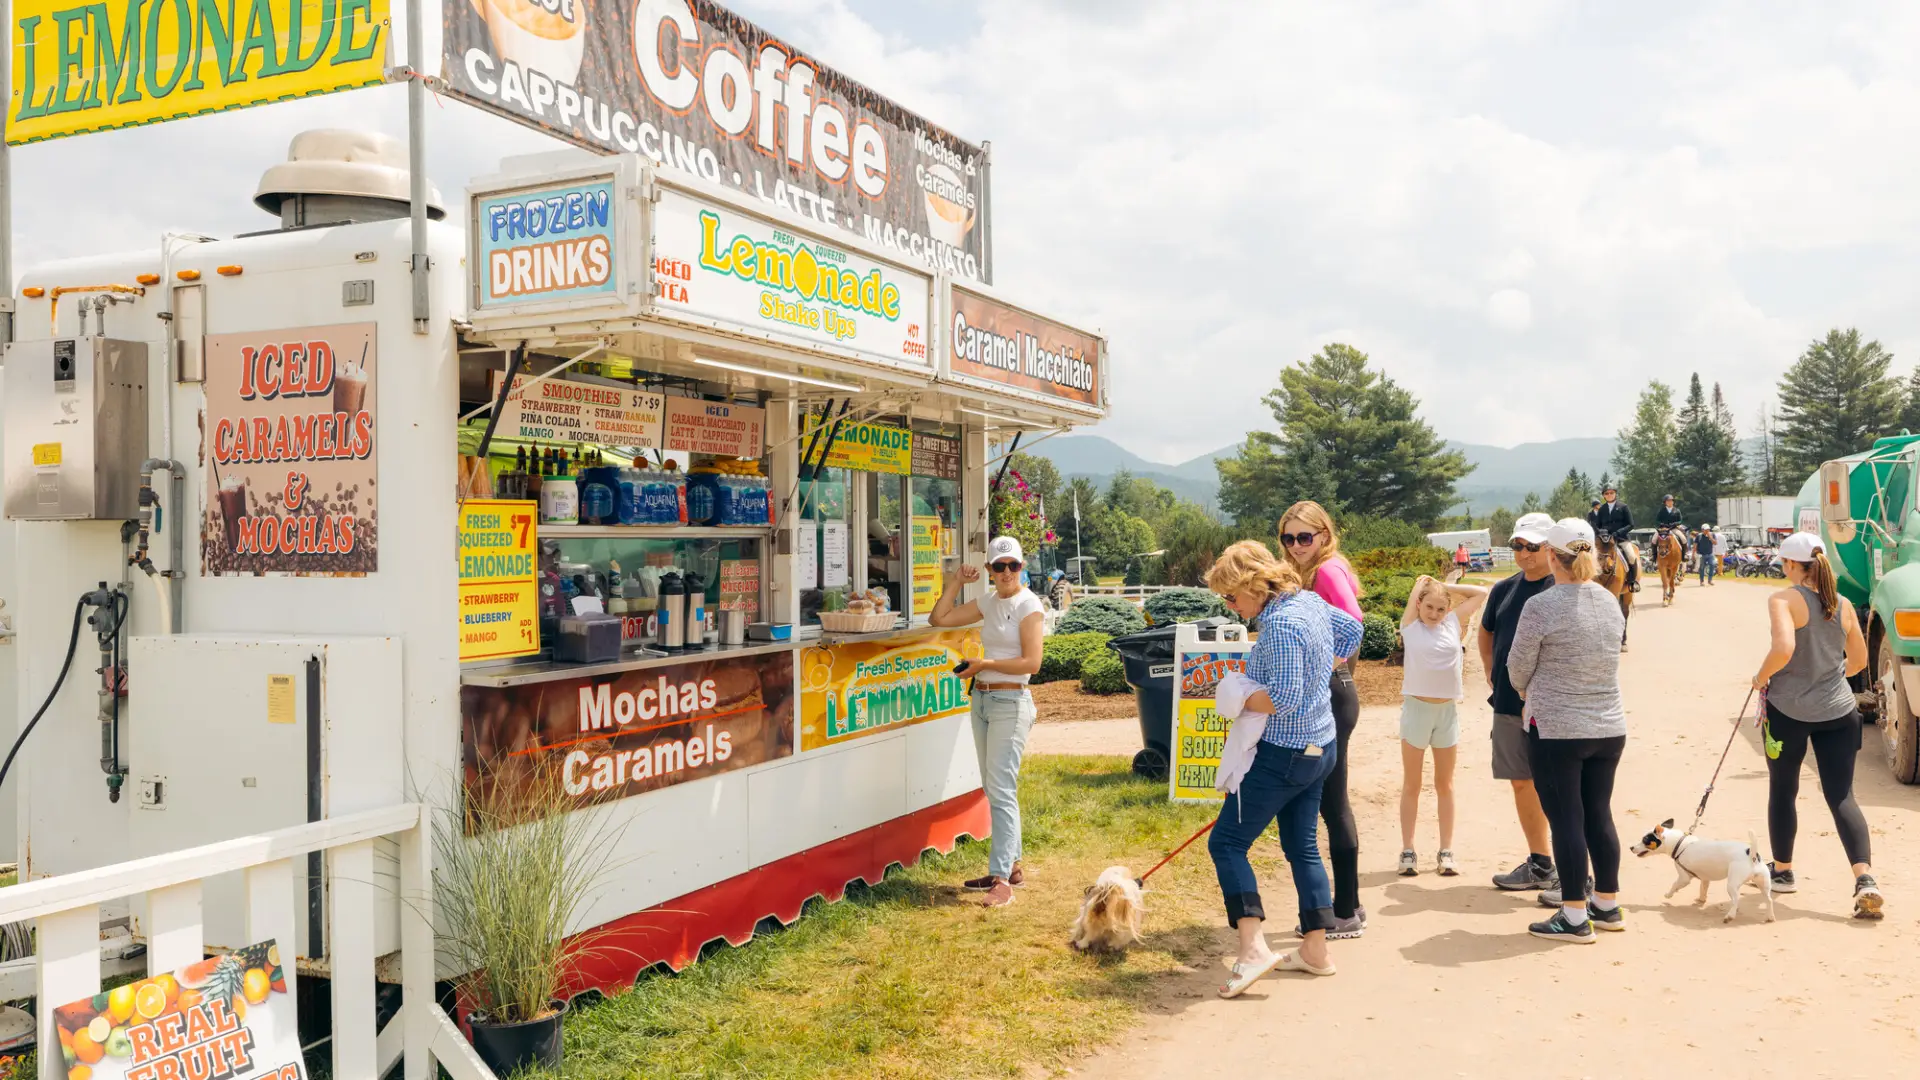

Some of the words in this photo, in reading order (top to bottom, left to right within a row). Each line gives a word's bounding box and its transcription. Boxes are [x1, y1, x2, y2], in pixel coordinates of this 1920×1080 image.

[15, 0, 381, 122] LEMONADE
[633, 0, 888, 197] Coffee
[914, 127, 962, 171] Mochas
[965, 154, 976, 176] &
[464, 48, 720, 184] CAPPUCCINO
[755, 174, 836, 226] LATTE
[864, 213, 977, 281] MACCHIATO
[916, 164, 975, 209] Caramels
[488, 190, 609, 242] FROZEN
[773, 230, 795, 247] FRESH
[491, 237, 611, 296] DRINKS
[815, 245, 847, 264] SQUEEZED
[658, 279, 689, 304] TEA
[760, 292, 820, 331] Shake
[824, 307, 857, 341] Ups
[954, 311, 1021, 375] Caramel
[1025, 335, 1093, 393] Macchiato
[239, 340, 336, 399] ICED
[543, 383, 622, 407] SMOOTHIES
[521, 399, 582, 416] STRAWBERRY
[705, 405, 729, 417] ICED
[519, 426, 554, 439] MANGO
[520, 411, 543, 425] PIÑA
[545, 415, 581, 429] COLADA
[595, 420, 644, 435] CREAMSICLE
[670, 426, 695, 439] LATTE
[671, 413, 705, 427] CARAMEL
[706, 417, 746, 432] MACCHIATO
[214, 410, 373, 464] CARAMELS
[669, 438, 689, 450] CHAI
[922, 436, 940, 452] SWEET
[940, 439, 950, 453] TEA
[283, 470, 308, 511] &
[644, 493, 677, 508] AQUAFINA
[741, 497, 766, 509] AQUAFINA
[466, 513, 500, 529] FRESH
[236, 515, 356, 554] MOCHAS
[459, 531, 513, 550] SQUEEZED
[464, 592, 520, 606] STRAWBERRY
[465, 611, 513, 624] BLUEBERRY
[519, 619, 532, 627] ADD
[465, 631, 497, 644] MANGO
[856, 657, 893, 678] Fresh
[894, 649, 948, 674] Squeezed
[1183, 653, 1211, 669] ICED
[579, 675, 718, 732] Mochas
[826, 671, 970, 739] LEMONADE
[1182, 735, 1226, 758] SQUE
[562, 724, 732, 796] Caramels
[1178, 765, 1218, 788] LEM
[126, 997, 239, 1067] REAL
